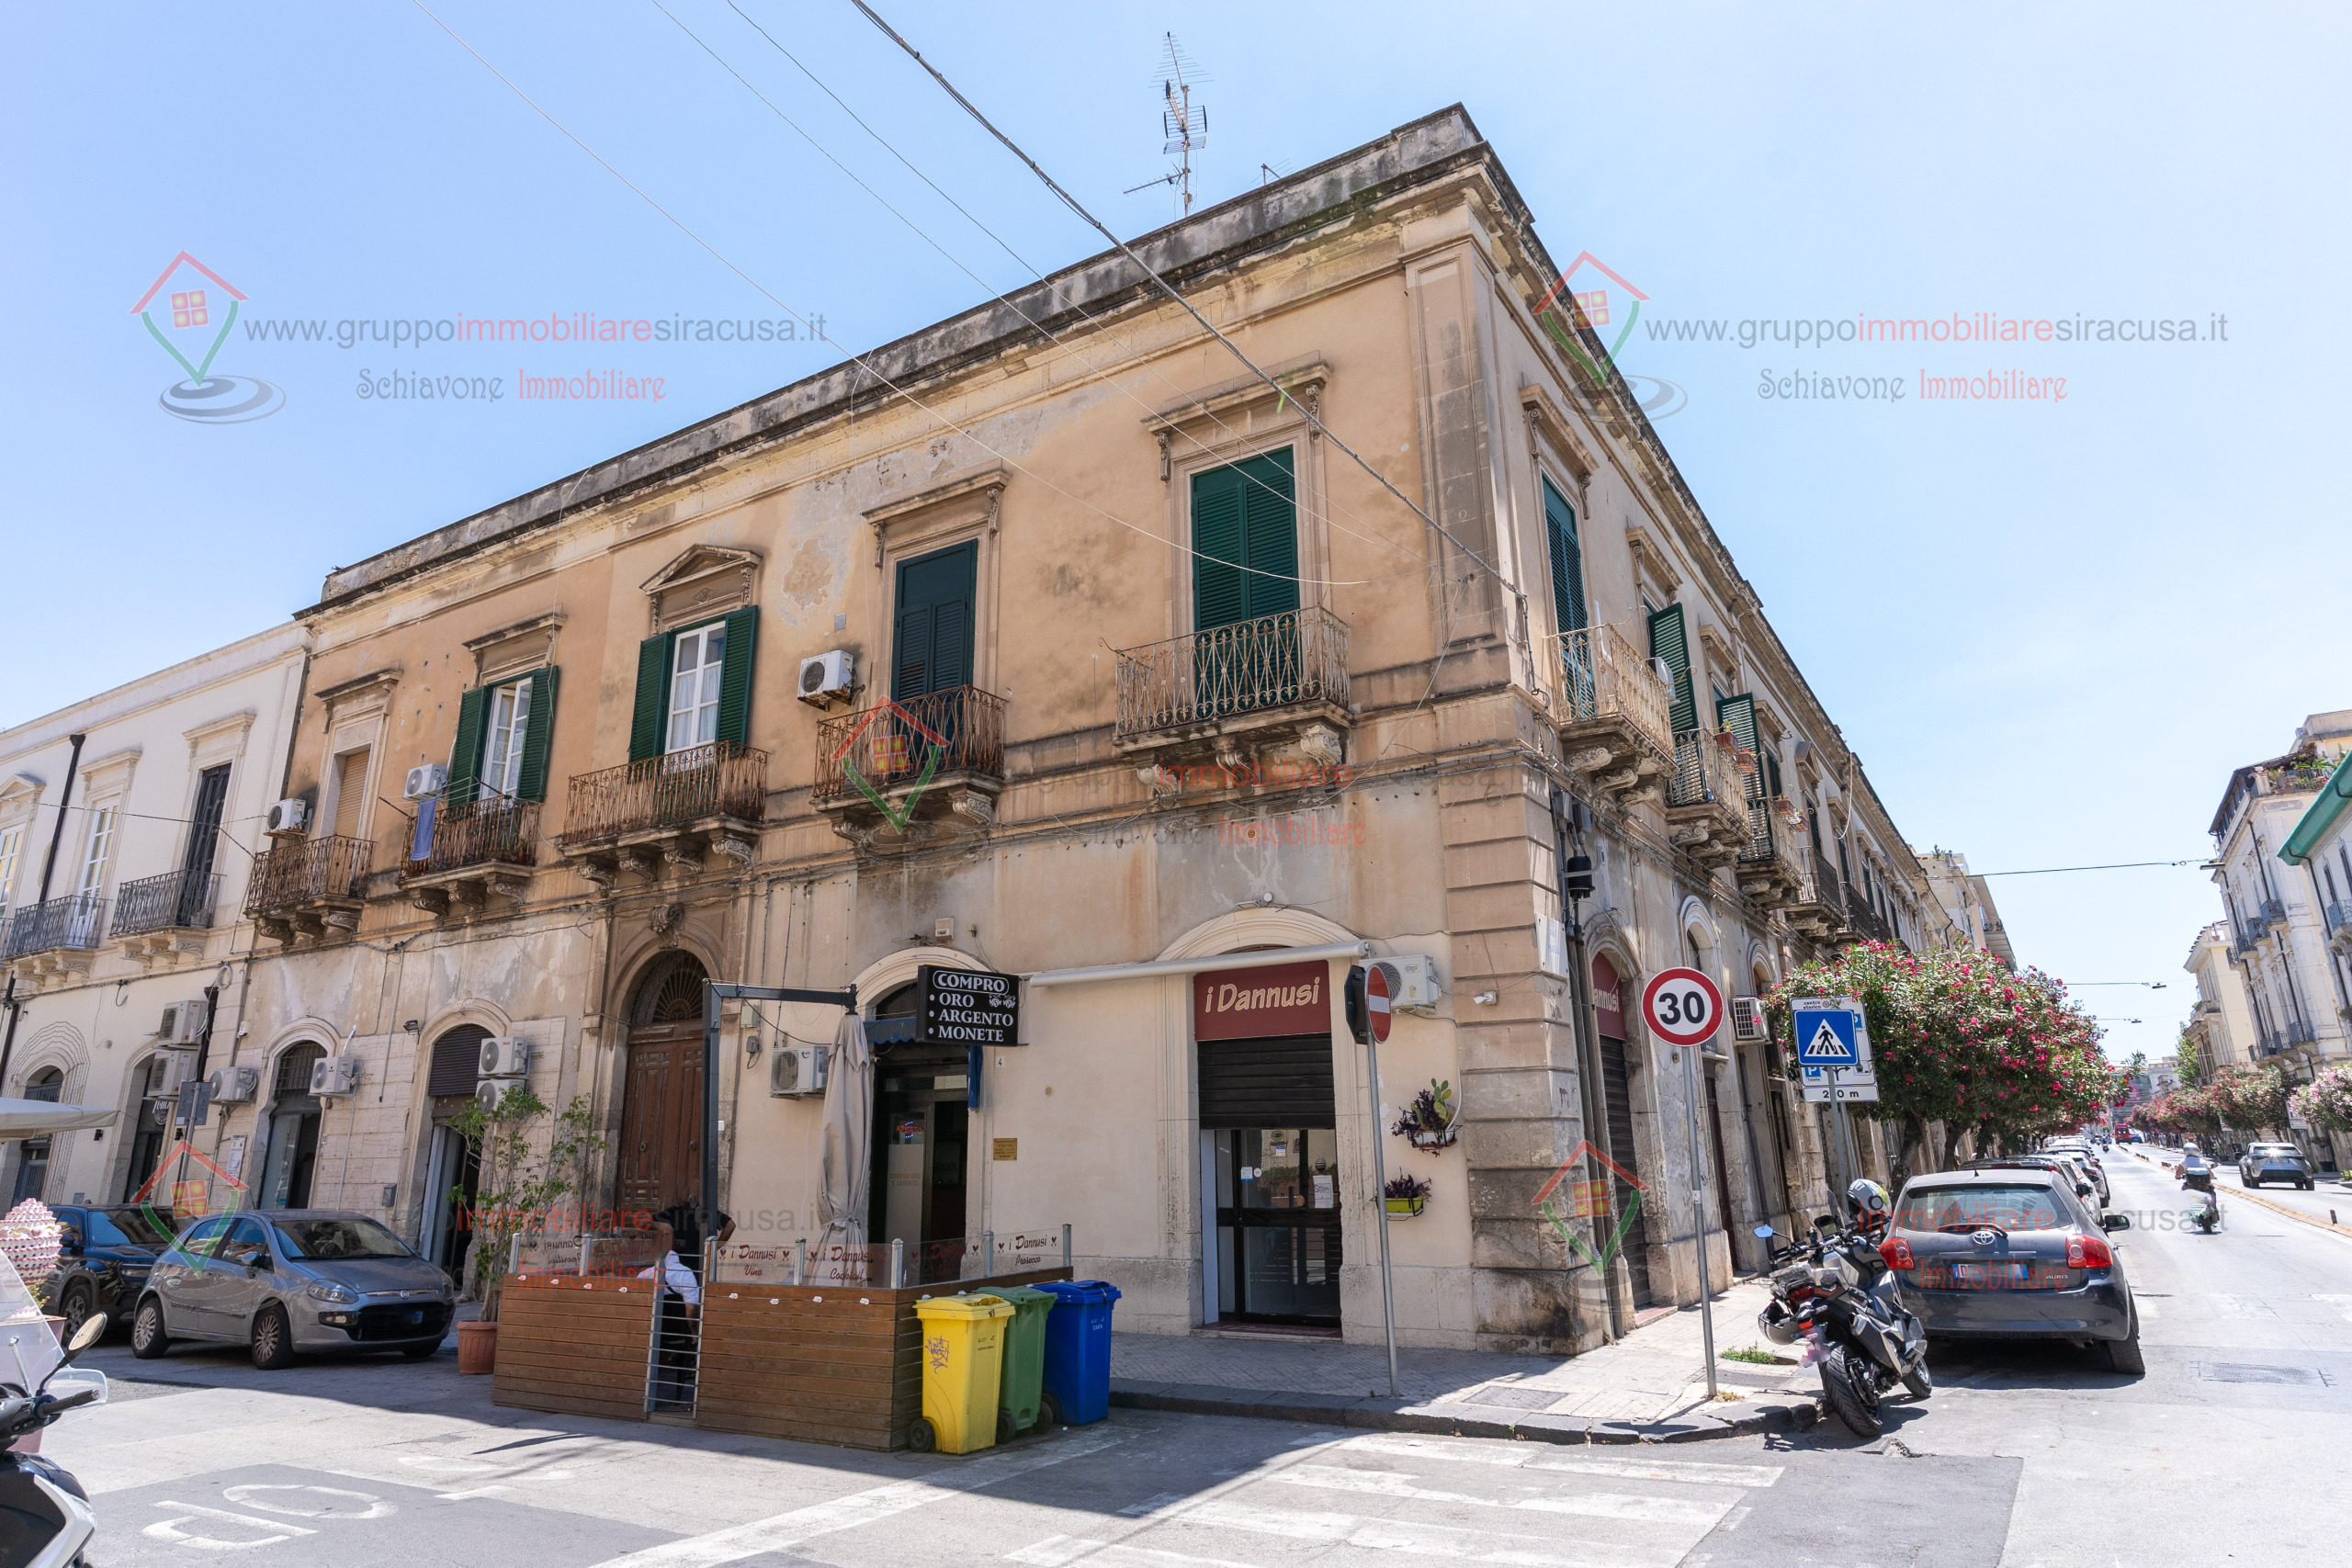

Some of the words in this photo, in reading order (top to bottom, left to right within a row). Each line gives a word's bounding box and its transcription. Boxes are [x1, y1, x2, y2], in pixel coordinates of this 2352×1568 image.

[937, 973, 1005, 993] COMPRO
[939, 992, 974, 1008] ORO
[1205, 986, 1214, 1013] i
[1217, 976, 1320, 1012] Dannusi
[1658, 991, 1705, 1025] 30
[938, 1009, 1014, 1027] ARGENTO
[937, 1025, 1004, 1043] MONETE
[998, 1057, 1002, 1066] 4
[1808, 1066, 1816, 1076] P
[1822, 1089, 1844, 1099] 20
[1015, 1235, 1047, 1250] Dannusi
[739, 1245, 777, 1260] Dannusi
[831, 1246, 873, 1263] Dannusi
[1014, 1254, 1042, 1267] Prosecco
[744, 1266, 763, 1277] Vino
[830, 1268, 864, 1281] Cocktail
